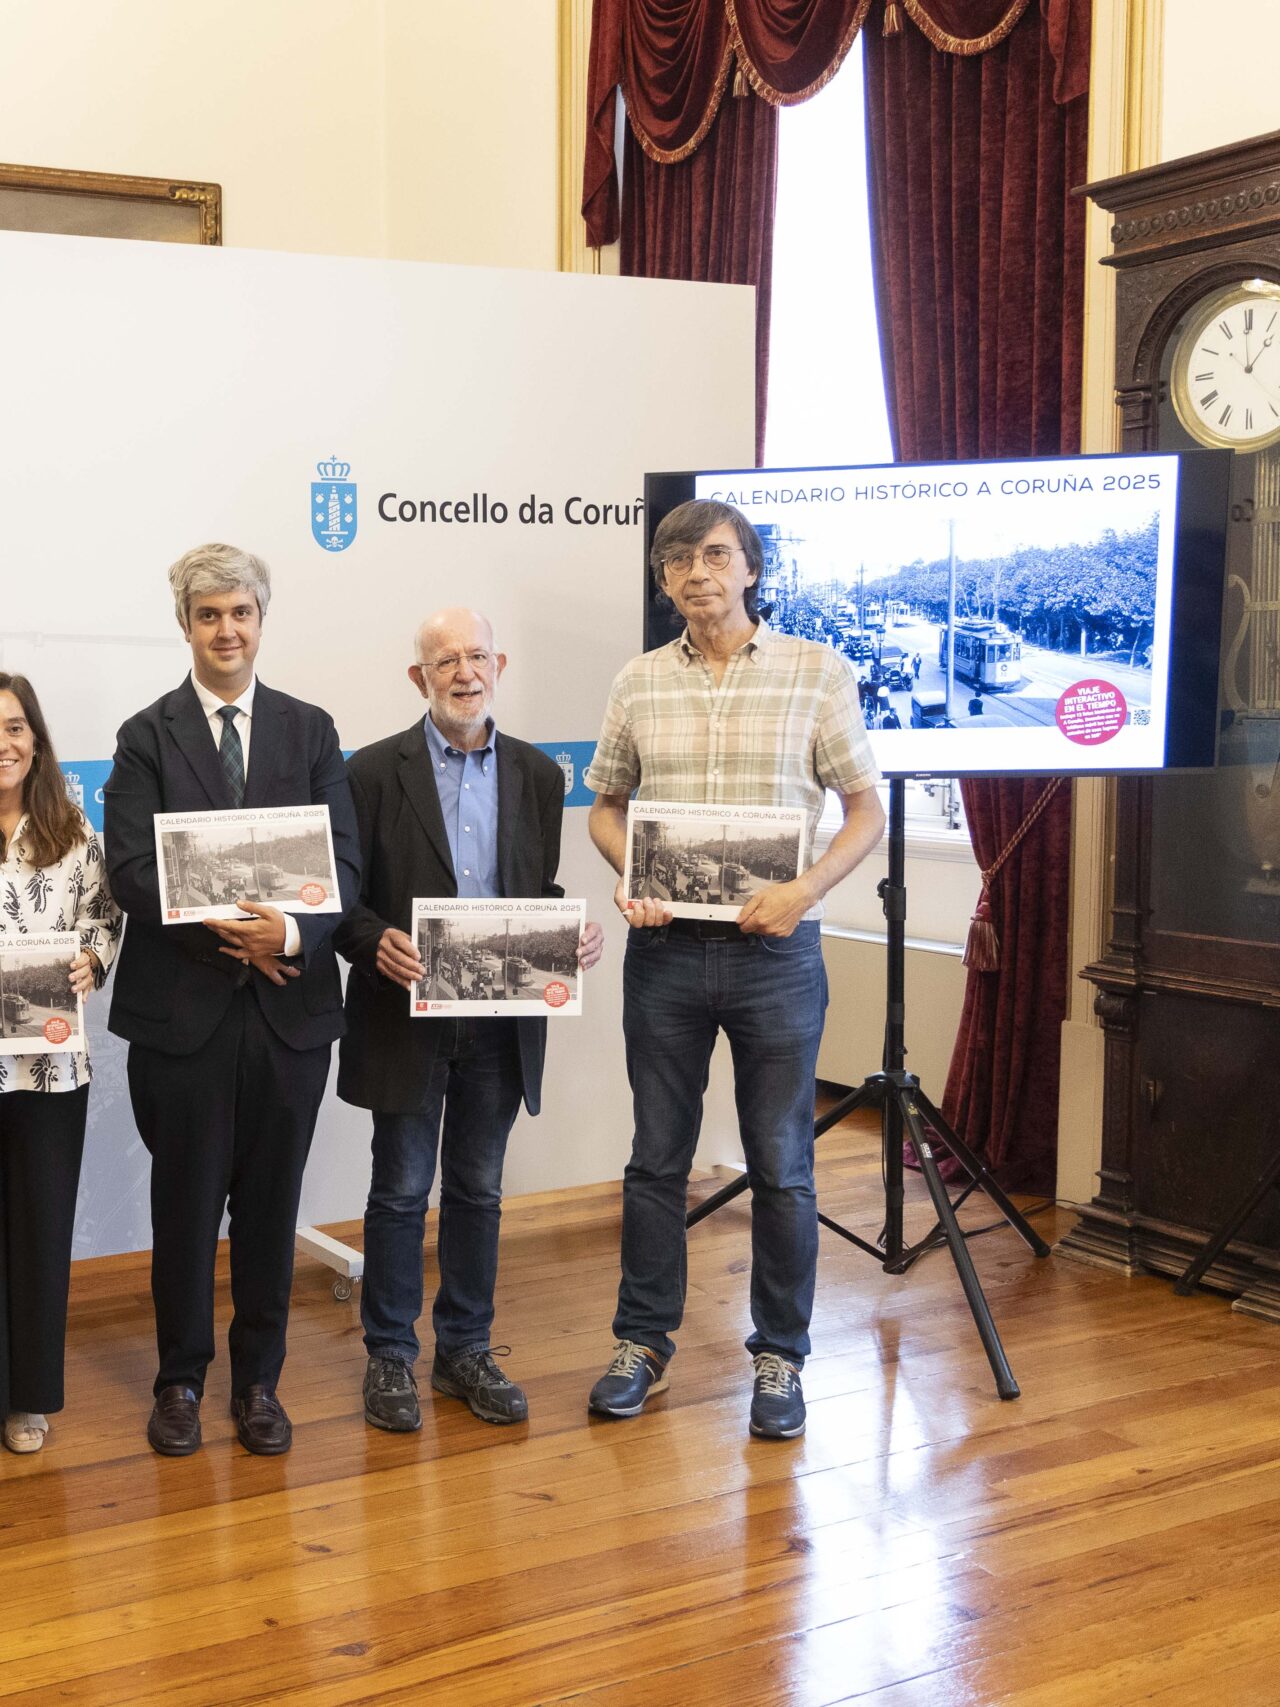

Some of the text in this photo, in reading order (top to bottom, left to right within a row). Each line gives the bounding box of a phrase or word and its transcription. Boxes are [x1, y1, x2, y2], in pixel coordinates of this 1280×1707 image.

[710, 474, 1161, 505] CALENDARIO HISTÓRICO A CORUÑA 2025
[377, 493, 645, 526] Concello da Coruñ
[1064, 691, 1116, 706] INTERACTIVO
[1077, 686, 1101, 696] VIAJE
[1086, 699, 1117, 711] TIEMPO
[160, 816, 212, 826] CALENDARIO
[214, 813, 257, 823] HISTÓRICO
[266, 810, 301, 820] CORUÑA
[633, 806, 686, 816] CALENDARIO
[688, 808, 732, 818] HISTÓRICO
[742, 810, 777, 820] CORUÑA
[779, 813, 801, 821] 2025
[417, 903, 581, 912] CALENDARIO HISTÓRICO A CORUÑA 2025
[15, 937, 52, 947] CORUÑA
[53, 937, 76, 945] 2025
